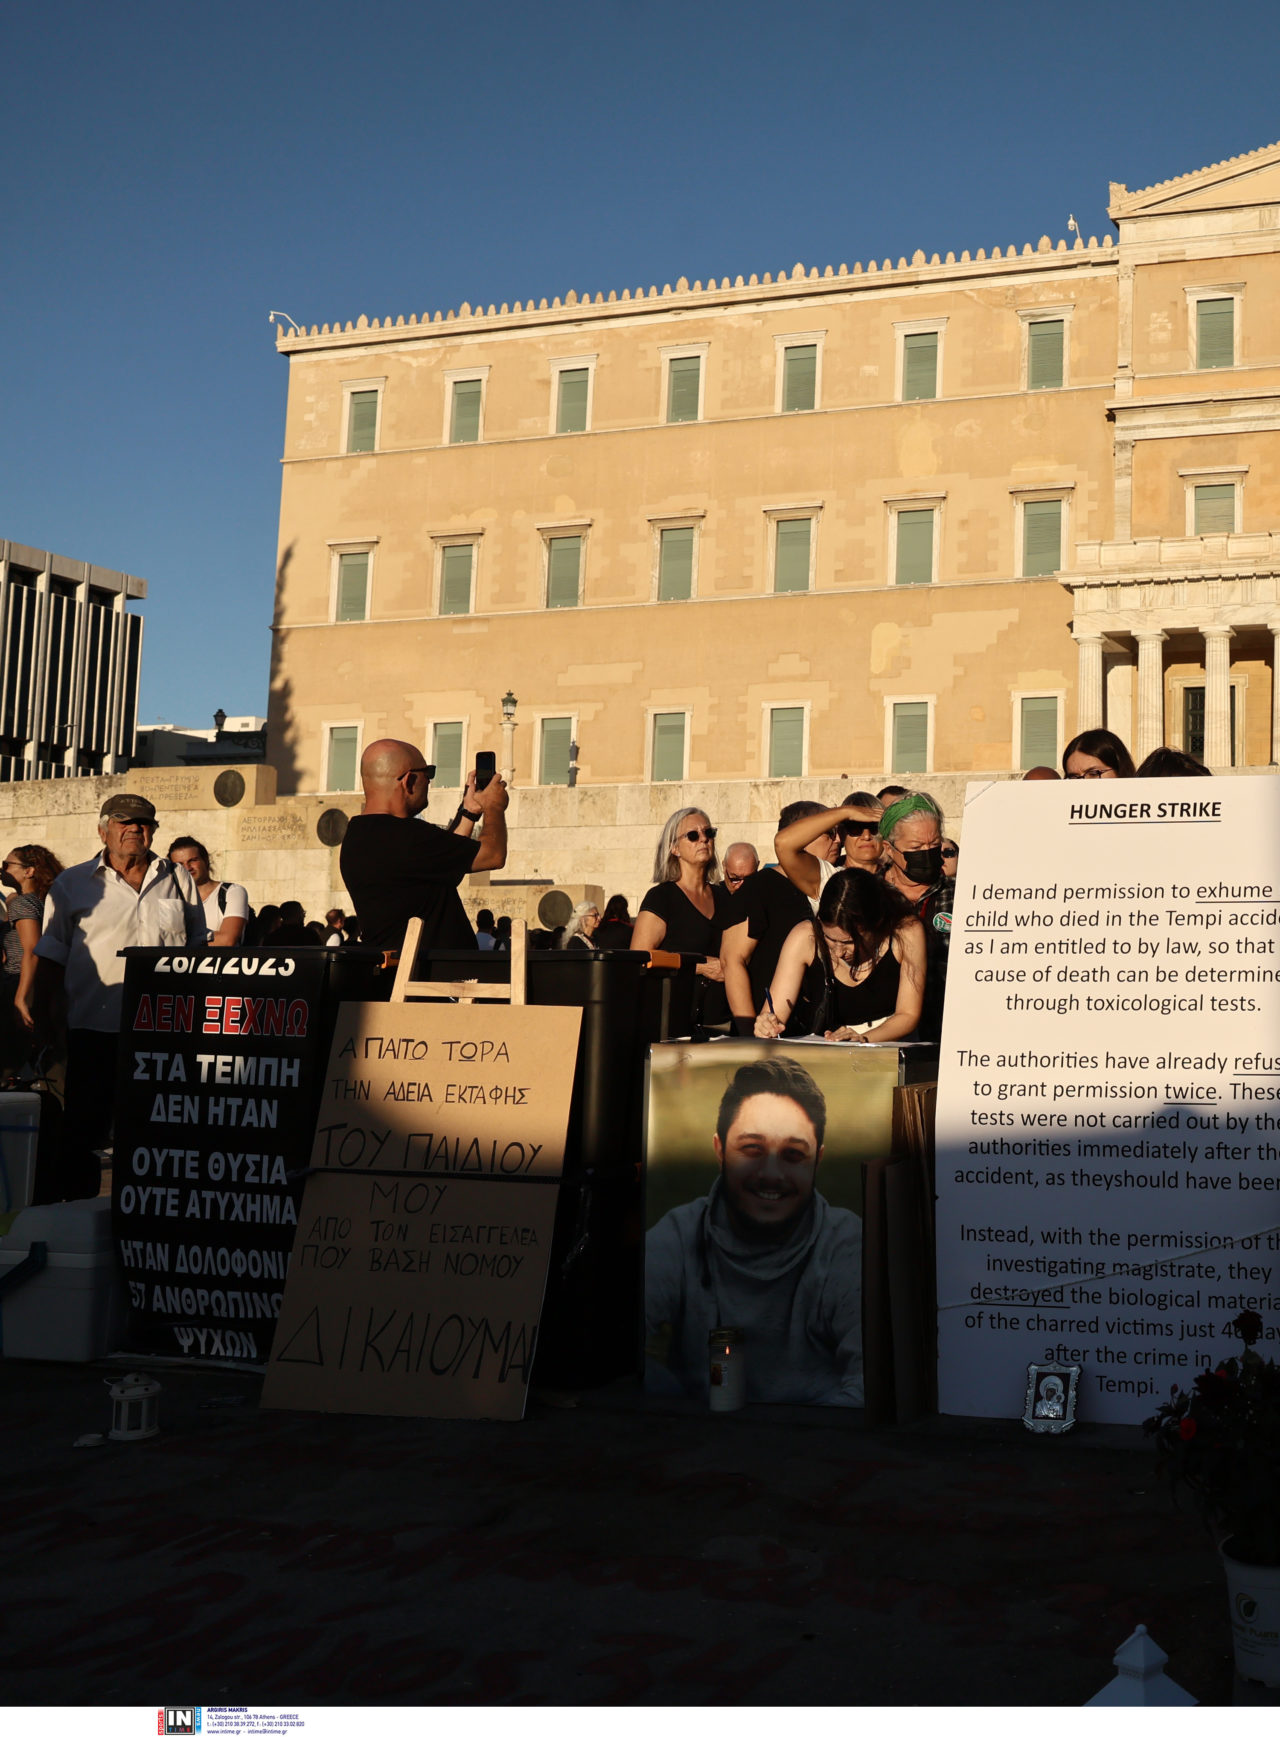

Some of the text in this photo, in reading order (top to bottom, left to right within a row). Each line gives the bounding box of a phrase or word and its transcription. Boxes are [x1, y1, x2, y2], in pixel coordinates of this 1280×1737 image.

[1071, 802, 1221, 819] HUNGER STRIKE
[973, 884, 976, 900] I
[983, 883, 1057, 900] demand
[1064, 883, 1164, 903] permission
[1171, 884, 1190, 899] to
[1197, 881, 1272, 898] exhume
[966, 910, 1008, 927] child
[1015, 910, 1053, 927] who
[1060, 909, 1099, 927] died
[1106, 910, 1121, 926] in
[1129, 909, 1159, 926] the
[1166, 909, 1221, 930] Tempi
[965, 942, 983, 954] as
[990, 939, 993, 954] I
[1000, 942, 1027, 954] am
[1035, 938, 1106, 954] entitled
[1112, 940, 1131, 954] to
[1138, 938, 1160, 958] by
[1167, 937, 1201, 957] law,
[1209, 942, 1229, 954] so
[1236, 937, 1275, 953] that
[975, 969, 1026, 982] cause
[1033, 965, 1051, 982] of
[1057, 965, 1109, 982] death
[1117, 969, 1148, 982] can
[1156, 965, 1178, 982] be
[133, 994, 309, 1038] ΔΕΝ ΞΕΧΝΩ
[1006, 993, 1260, 1015] through toxicological tests.
[133, 1052, 300, 1088] ΣΤΑ ΤΕΜΠΗ
[958, 1049, 990, 1067] The
[997, 1050, 1098, 1068] authorities
[1106, 1050, 1149, 1070] have
[1156, 1051, 1227, 1074] already
[332, 1079, 531, 1105] ΤΗΝ ΑΔΕΙΑ ΕΚΤΑΦΗΣ
[974, 1080, 992, 1096] to
[998, 1082, 1047, 1100] grant
[1054, 1081, 1157, 1102] permission
[1165, 1082, 1221, 1100] twice.
[150, 1093, 279, 1129] ΔΕΝ ΗΤΑΝ
[971, 1110, 1014, 1126] tests
[1021, 1113, 1067, 1127] were
[1075, 1111, 1106, 1128] not
[1112, 1109, 1179, 1130] carried
[1186, 1113, 1219, 1130] out
[1227, 1111, 1249, 1135] by
[319, 1123, 543, 1174] ΤΟΥ ΠΑΙΔΙΟΥ
[968, 1137, 1071, 1157] authorities
[1078, 1139, 1198, 1164] immediately
[1205, 1141, 1251, 1161] after
[132, 1146, 288, 1185] ΟΥΤΕ ΘΥΣΙΑ
[955, 1166, 1038, 1189] accident,
[1046, 1172, 1065, 1186] as
[1071, 1167, 1178, 1192] theyshould
[1186, 1171, 1231, 1190] have
[120, 1184, 298, 1225] ΟΥΤΕ ΑΤΥΧΗΜΑ
[369, 1181, 448, 1215] ΜΟΥ
[308, 1215, 539, 1247] ΑΠΟ ΤΟΝ ΕΙΣΑΓΓΕΛΕΑ
[961, 1224, 1034, 1247] Instead,
[1041, 1226, 1082, 1245] with
[1088, 1227, 1120, 1246] the
[1128, 1231, 1234, 1255] permission
[1241, 1234, 1263, 1250] of
[120, 1239, 291, 1280] ΗΤΑΝ ΔΟΛΟΦΟΝΙ
[300, 1244, 524, 1278] ΠΟΥ ΒΑΣΗ ΝΟΜΟΥ
[987, 1254, 1272, 1285] investigating magistrate, they
[128, 1280, 284, 1319] 57 ΑΝΘΡΩΠΙΝΩ
[971, 1281, 1064, 1306] destroyed
[1070, 1283, 1102, 1305] the
[1109, 1286, 1200, 1312] biological
[965, 1310, 983, 1329] of
[989, 1312, 1020, 1330] the
[1026, 1313, 1099, 1334] charred
[1105, 1316, 1173, 1337] victims
[1180, 1319, 1215, 1341] just
[173, 1327, 257, 1359] ΨΥΧΩΝ
[1045, 1343, 1211, 1367] after the crime in
[1095, 1374, 1159, 1398] Tempi.
